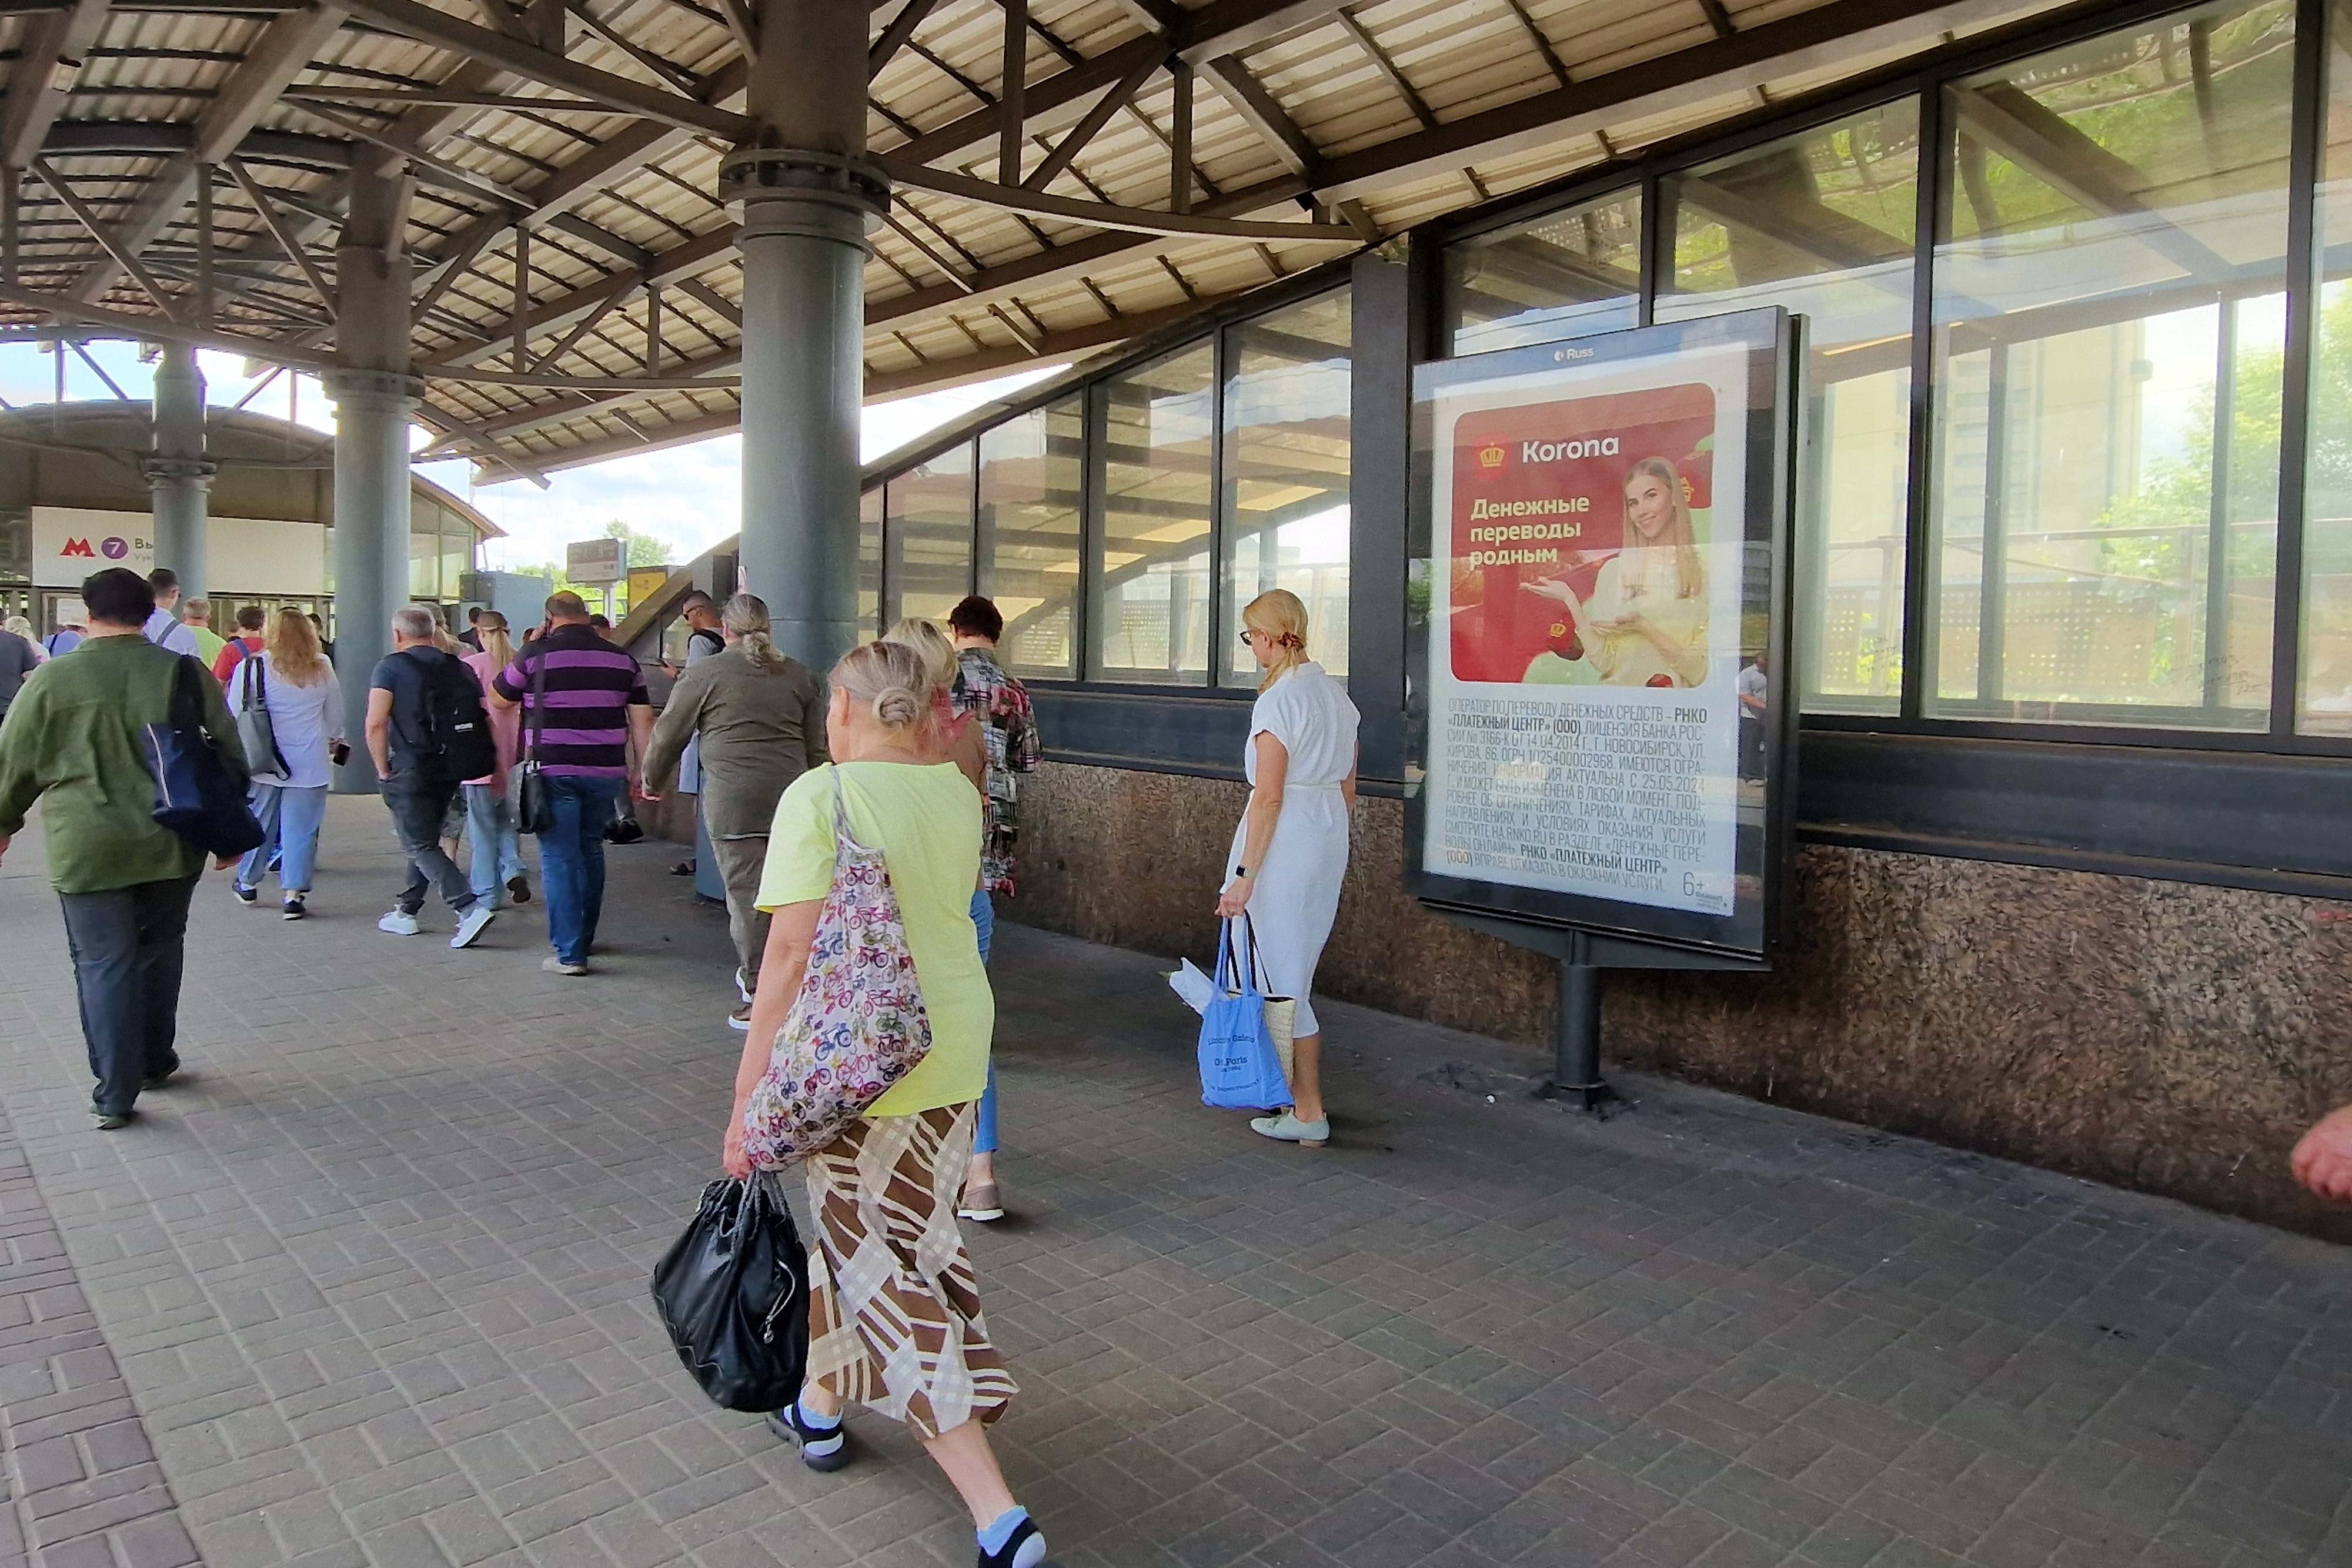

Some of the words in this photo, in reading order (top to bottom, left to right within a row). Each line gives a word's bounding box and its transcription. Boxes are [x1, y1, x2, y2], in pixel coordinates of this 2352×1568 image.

[1566, 348, 1594, 360] Russ
[1522, 436, 1620, 463] Korona
[1470, 496, 1590, 521] Денежные
[1470, 522, 1581, 546] переводы
[108, 541, 120, 555] 7
[1469, 547, 1558, 570] родным
[1449, 698, 1491, 713] ОПЕРАТОР
[1492, 700, 1505, 715] ПО
[1506, 701, 1556, 718] ПЕРЕВОДУ
[1559, 703, 1613, 718] ДЕНЕЖНЫХ
[1617, 706, 1663, 722] СРЕДСТВ
[1675, 707, 1707, 724] РНКО
[1448, 714, 1510, 730] «ПЛАТЕЖНЫЙ
[1512, 717, 1551, 733] ЦЕНТР»
[1585, 720, 1640, 737] ЛИЦЕНЗИЯ
[1642, 724, 1676, 739] БАНКА
[1679, 725, 1706, 741] РОС-
[1448, 728, 1466, 742] СИИ
[1480, 731, 1509, 747] 3166-К
[1512, 732, 1524, 747] ОТ
[1527, 734, 1579, 750] 14.04.2014
[1605, 738, 1685, 758] НОВОСИБИРСК,
[1689, 743, 1706, 758] УЛ.
[1502, 747, 1525, 763] ОГРН
[1619, 756, 1671, 773] ИМЕЮТСЯ
[1675, 759, 1705, 775] ОГРА-
[1447, 760, 1489, 775] НИЧЕНИЯ.
[1494, 763, 1562, 781] ИНФОРМАЦИЯ
[1566, 768, 1624, 787] АКТУАЛЬНА
[1630, 773, 1637, 788] С
[1642, 774, 1705, 793] 25.05.2024
[1463, 777, 1493, 791] МОЖЕТ
[1496, 779, 1521, 794] БЫТЬ
[1524, 781, 1575, 798] ИЗМЕНЕНА
[1578, 785, 1584, 800] В
[1586, 786, 1623, 804] ЛЮБОЙ
[1626, 790, 1673, 808] МОМЕНТ.
[1676, 794, 1705, 811] ПОД-
[1447, 789, 1476, 805] РОБНЕЕ
[1481, 793, 1492, 807] ОБ
[1496, 794, 1573, 815] ОГРАНИЧЕНИЯХ,
[1579, 801, 1627, 821] ТАРИФАХ,
[1632, 807, 1706, 828] АКТУАЛЬНЫХ
[1445, 805, 1515, 826] НАПРАВЛЕНИЯХ
[1522, 813, 1529, 826] И
[1536, 815, 1589, 833] УСЛОВИЯХ
[1598, 820, 1653, 840] ОКАЗАНИЯ
[1662, 827, 1705, 845] УСЛУГИ
[1445, 819, 1489, 838] СМОТРИТЕ
[1492, 825, 1504, 838] НА
[1549, 832, 1556, 846] В
[1558, 833, 1602, 851] РАЗДЕЛЕ
[1606, 838, 1671, 860] «ДЕНЕЖНЫЕ
[1673, 845, 1706, 862] ПЕРЕ-
[1445, 835, 1470, 850] ВОДЫ
[1521, 844, 1547, 860] РНКО
[1550, 848, 1622, 870] «ПЛАТЕЖНЫЙ
[1625, 858, 1668, 874] ЦЕНТР»
[1447, 850, 1473, 867] (ООО)
[1475, 852, 1509, 870] ВПРАВЕ
[1511, 857, 1557, 876] ОТКАЗАТЬ
[1559, 865, 1566, 877] В
[1568, 865, 1620, 884] ОКАЗАНИИ
[1623, 872, 1666, 892] УСЛУГИ.
[1683, 872, 1706, 896] 6+
